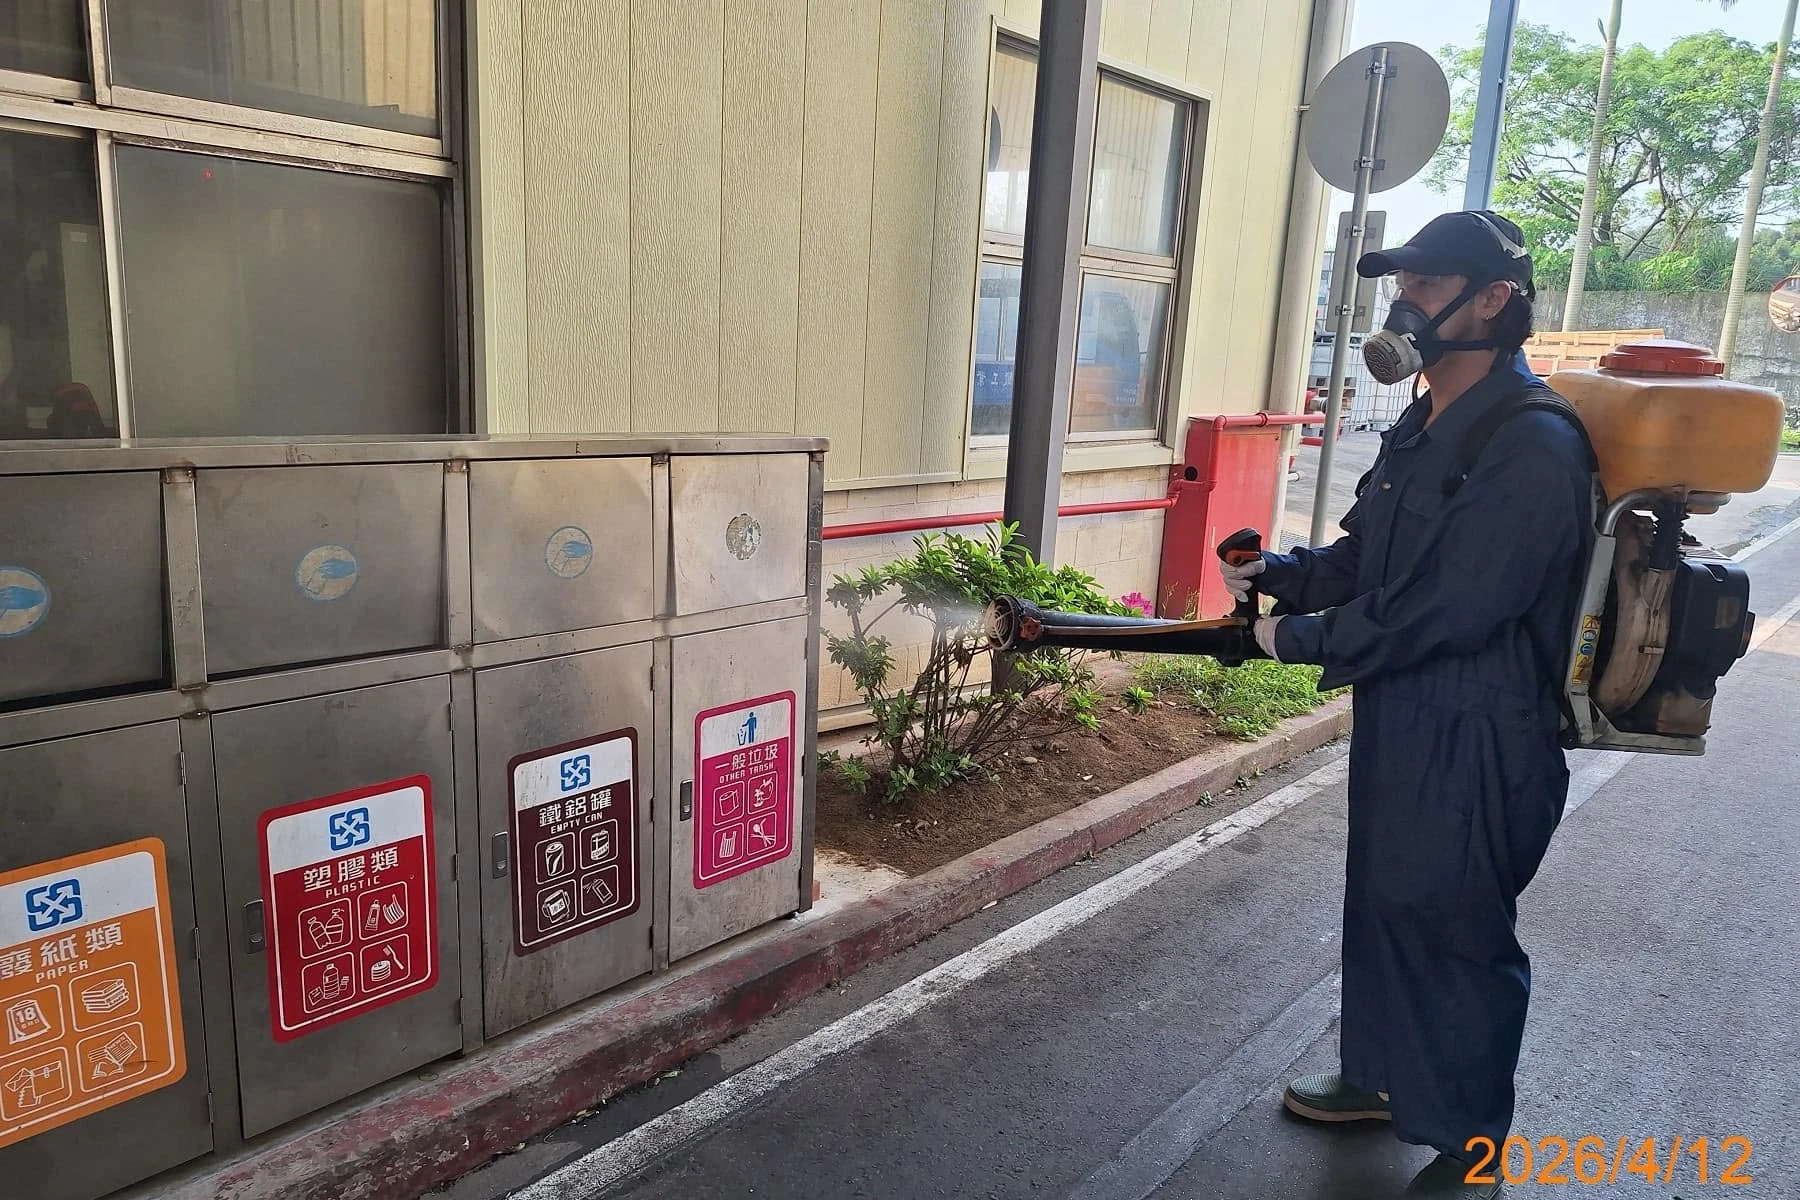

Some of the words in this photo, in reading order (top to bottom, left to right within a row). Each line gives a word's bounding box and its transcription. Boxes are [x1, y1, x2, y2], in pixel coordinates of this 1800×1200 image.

[715, 743, 778, 771] 一般垃圾
[719, 769, 746, 784] OTHER
[748, 760, 774, 775] TRASH
[538, 788, 612, 828] 鐵鋁罐
[550, 817, 581, 835] EMPTY
[584, 811, 603, 824] CAN
[303, 846, 399, 893] 塑膠類
[325, 875, 381, 899] PLASTIC
[35, 959, 89, 984] PAPER
[16, 1006, 37, 1024] 18
